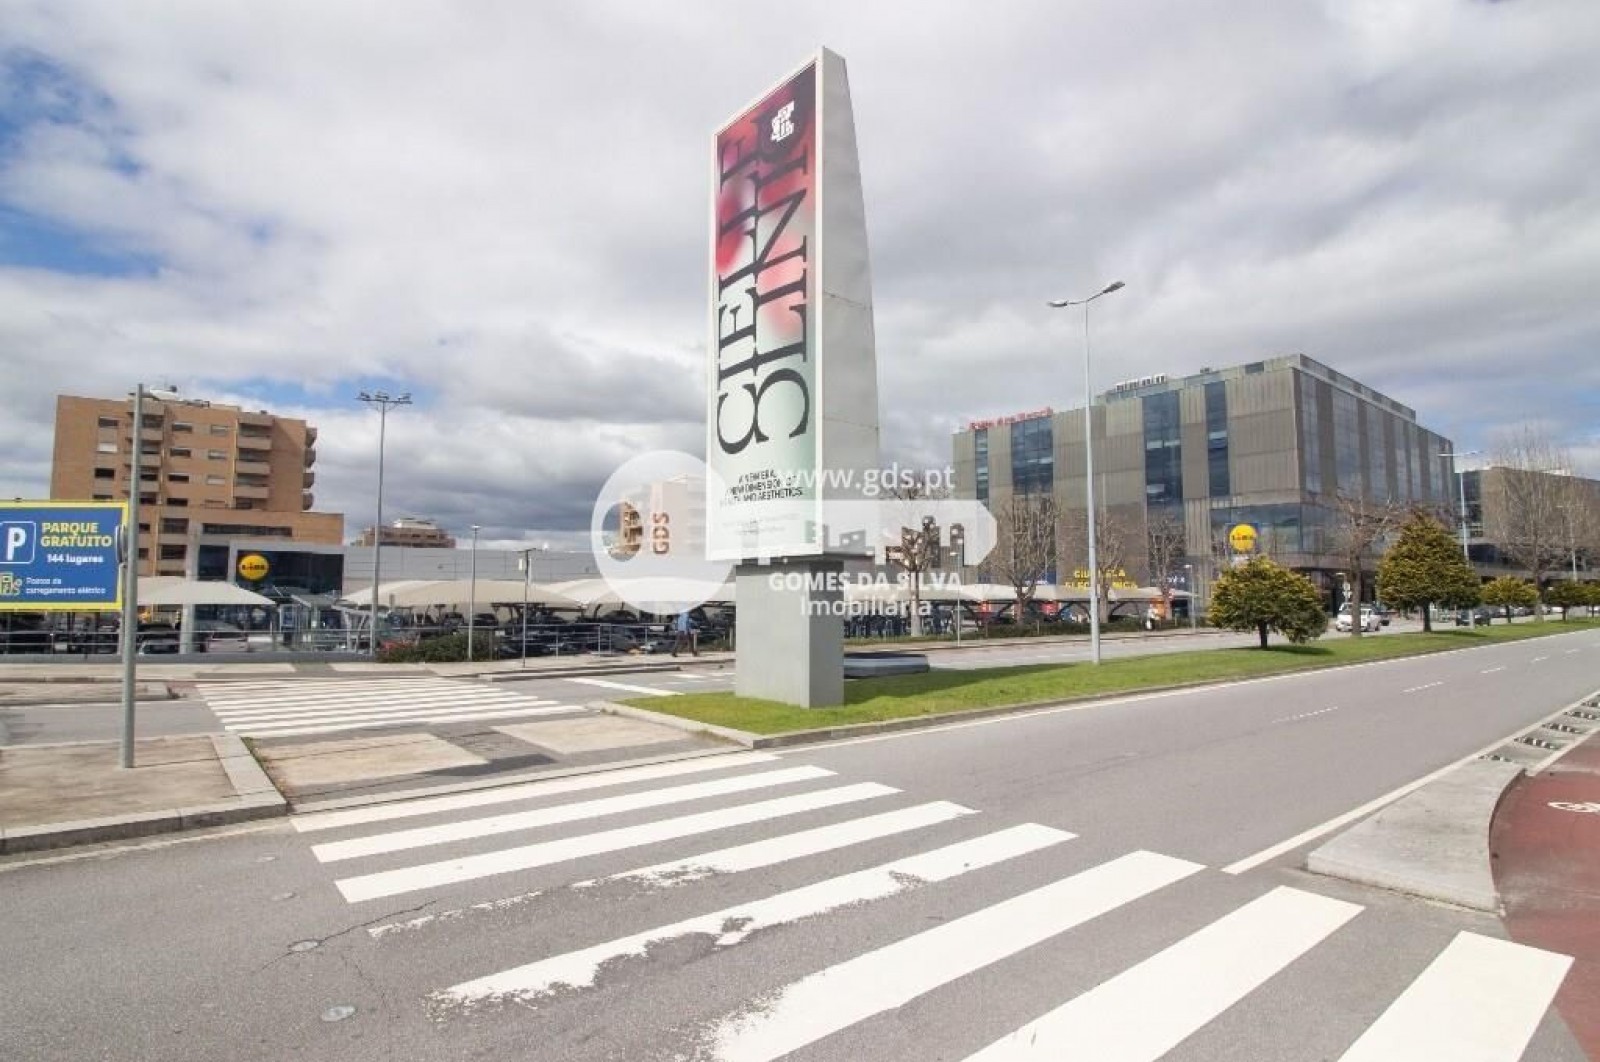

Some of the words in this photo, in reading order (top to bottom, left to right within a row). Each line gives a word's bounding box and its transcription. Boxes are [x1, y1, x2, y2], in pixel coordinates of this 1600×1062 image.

[41, 522, 99, 536] PARQUE
[6, 527, 26, 561] P
[40, 536, 112, 547] GRATUITO
[47, 554, 64, 563] 144
[66, 554, 104, 566] lugares
